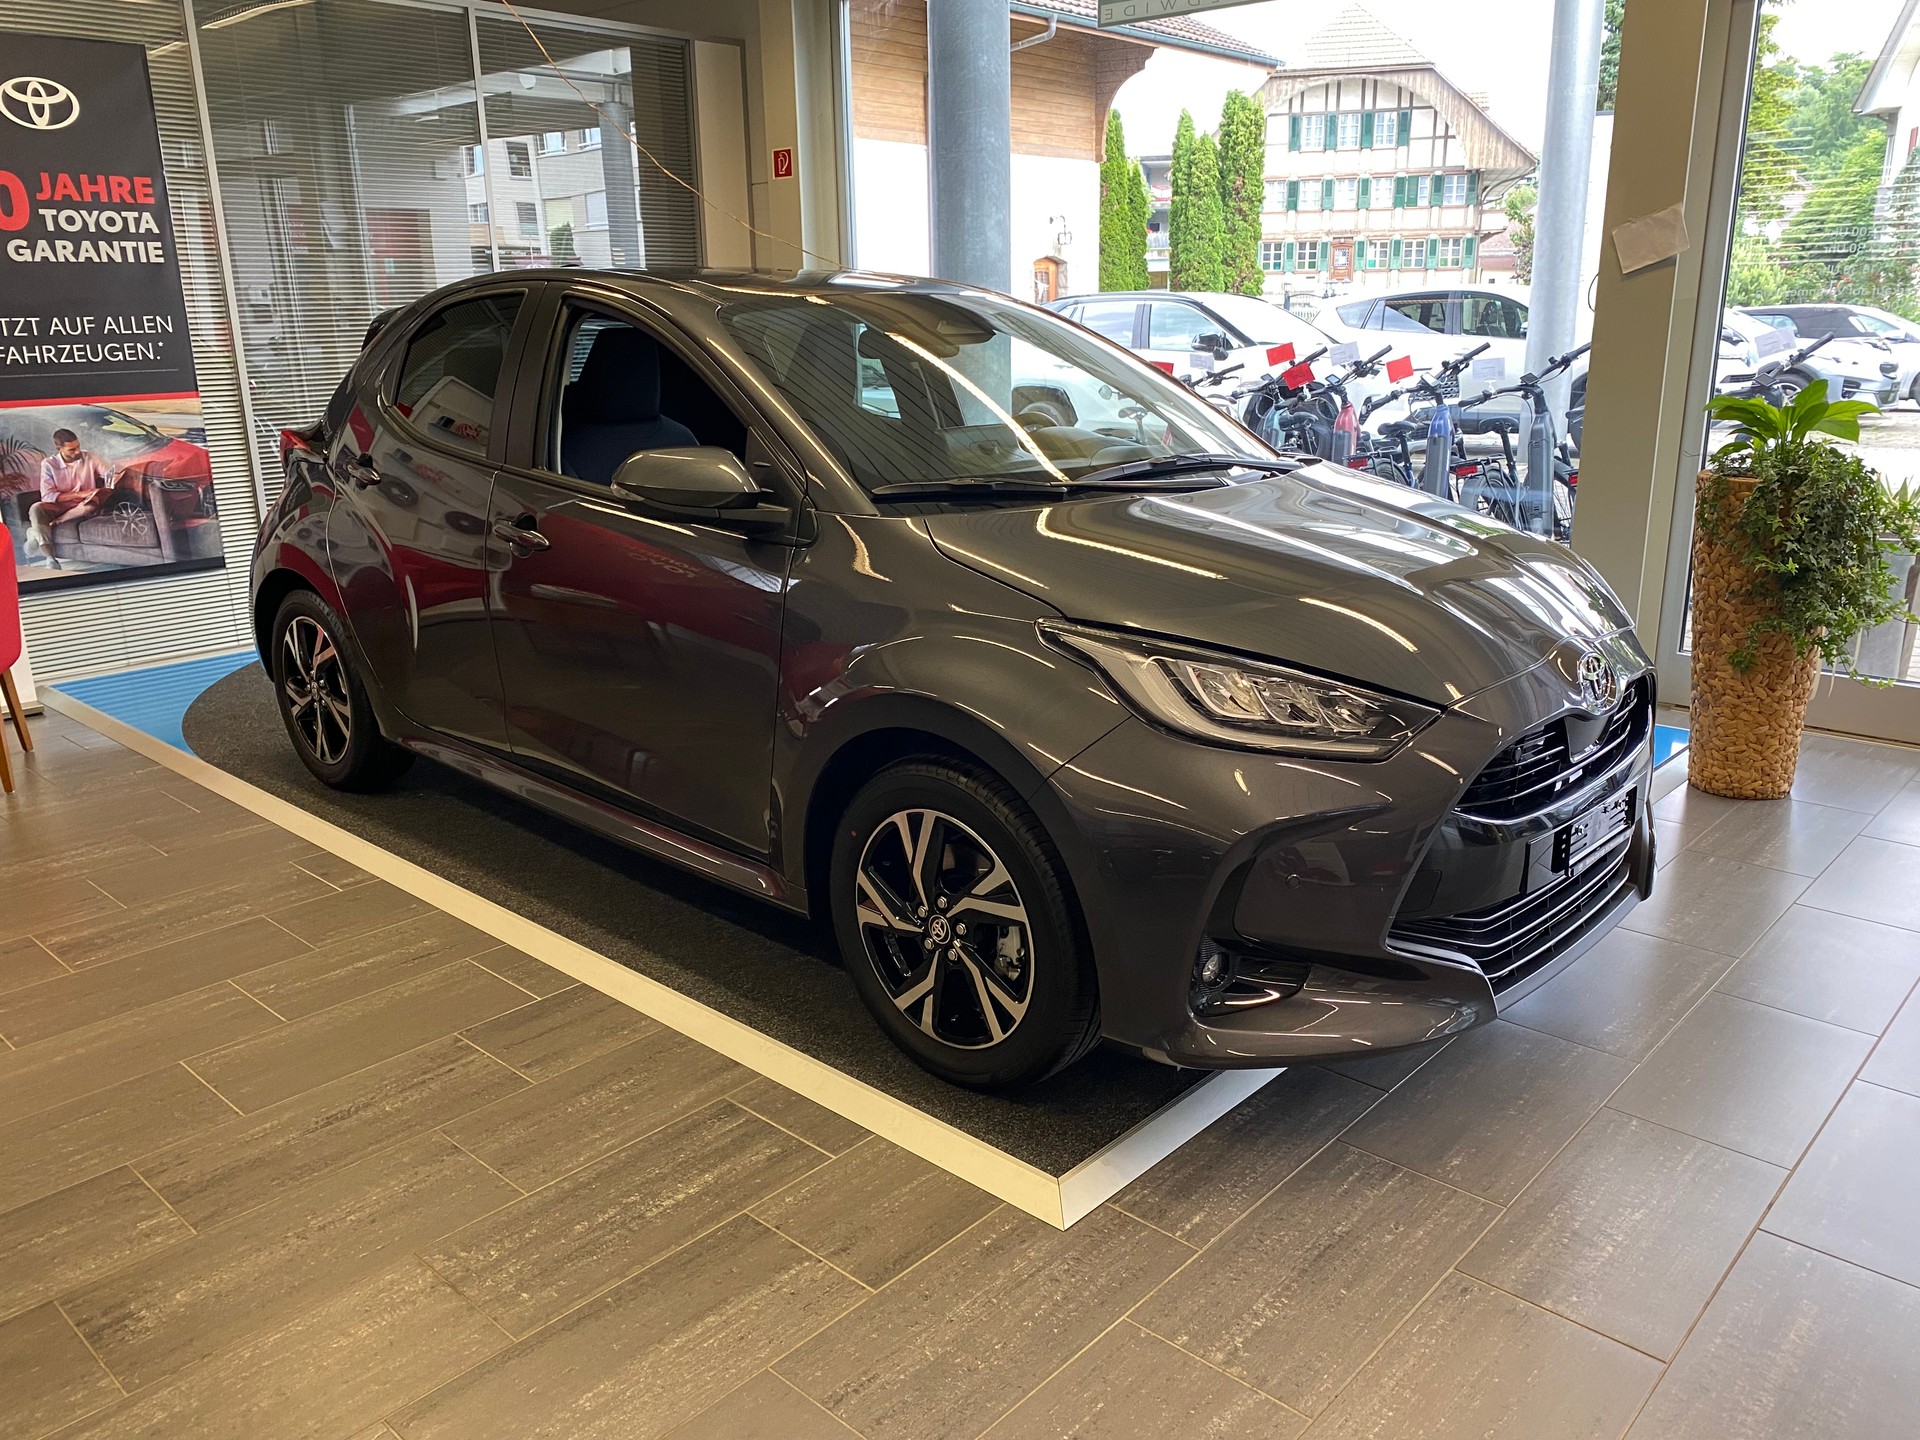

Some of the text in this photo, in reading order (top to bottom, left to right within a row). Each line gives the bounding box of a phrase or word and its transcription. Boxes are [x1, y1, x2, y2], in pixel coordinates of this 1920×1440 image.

[36, 172, 155, 204] JAHRE
[38, 208, 160, 234] TOYOTA
[6, 238, 165, 263] GARANTIE
[49, 316, 95, 336] AUF
[103, 315, 173, 335] ALLEN
